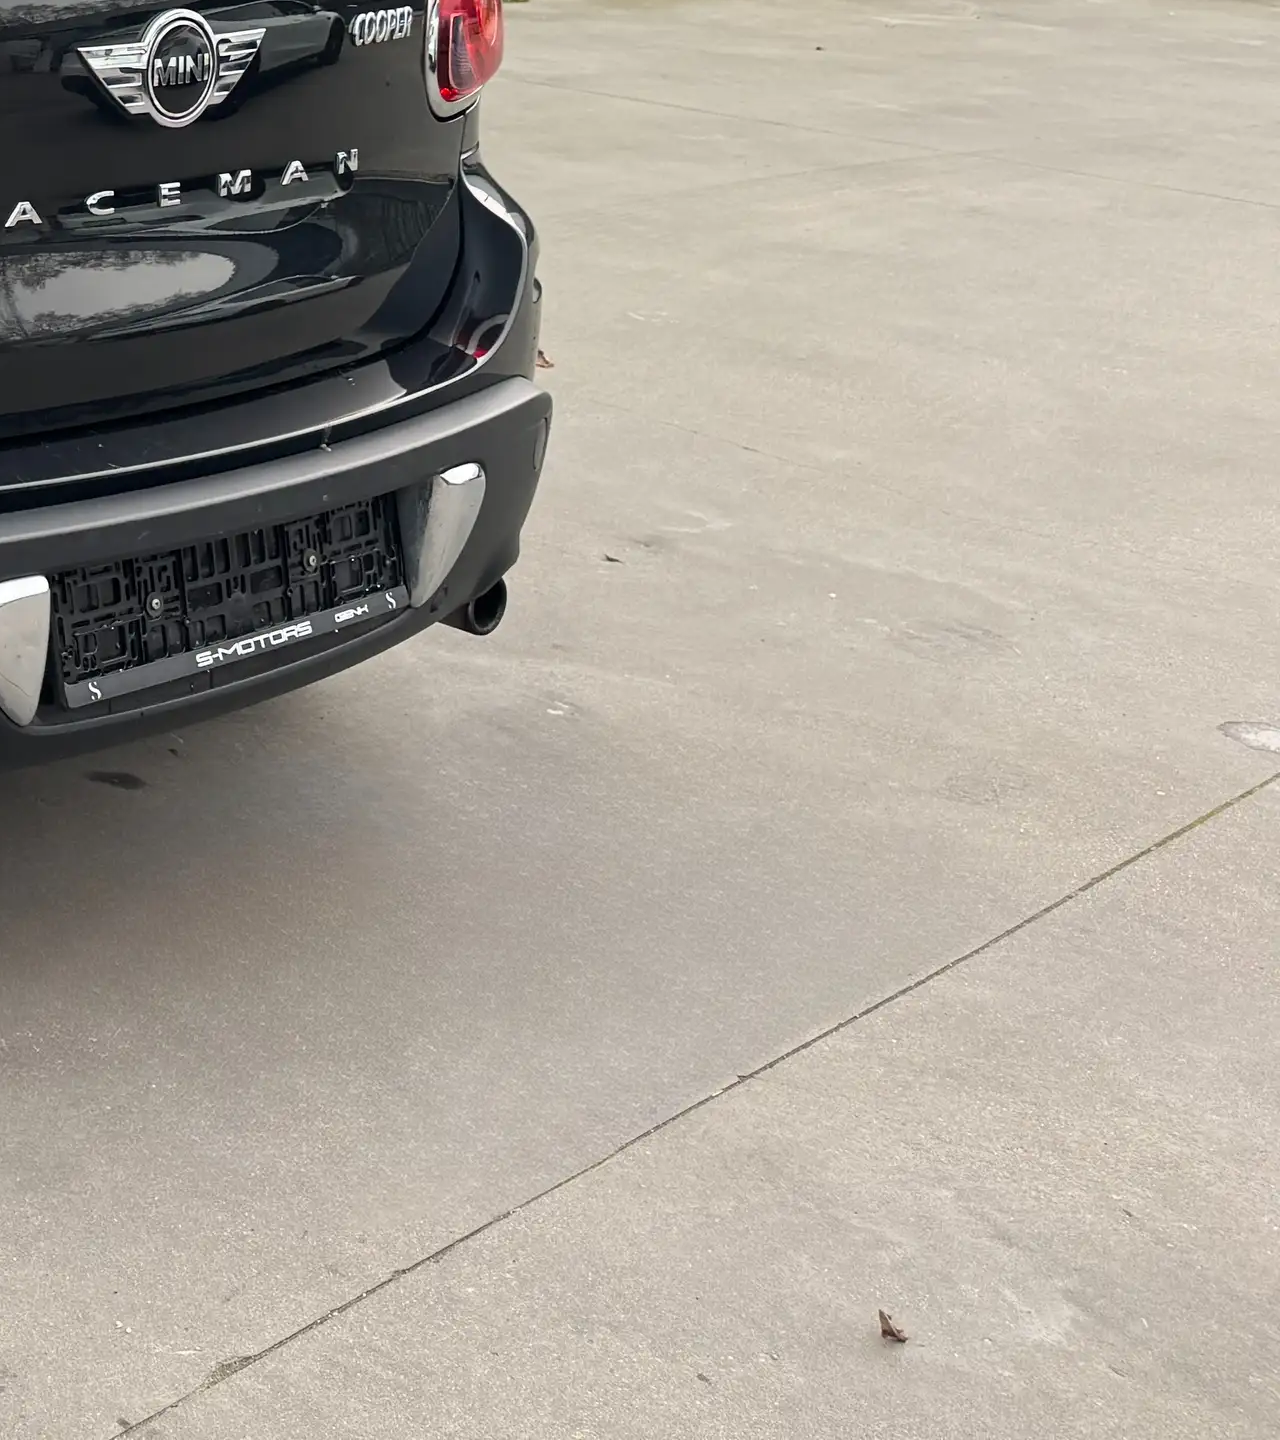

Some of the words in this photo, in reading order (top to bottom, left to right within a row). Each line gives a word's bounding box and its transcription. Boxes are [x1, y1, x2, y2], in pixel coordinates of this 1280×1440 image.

[353, 5, 413, 47] COOPER
[153, 52, 209, 87] MINI
[195, 620, 313, 668] S-MOTORS
